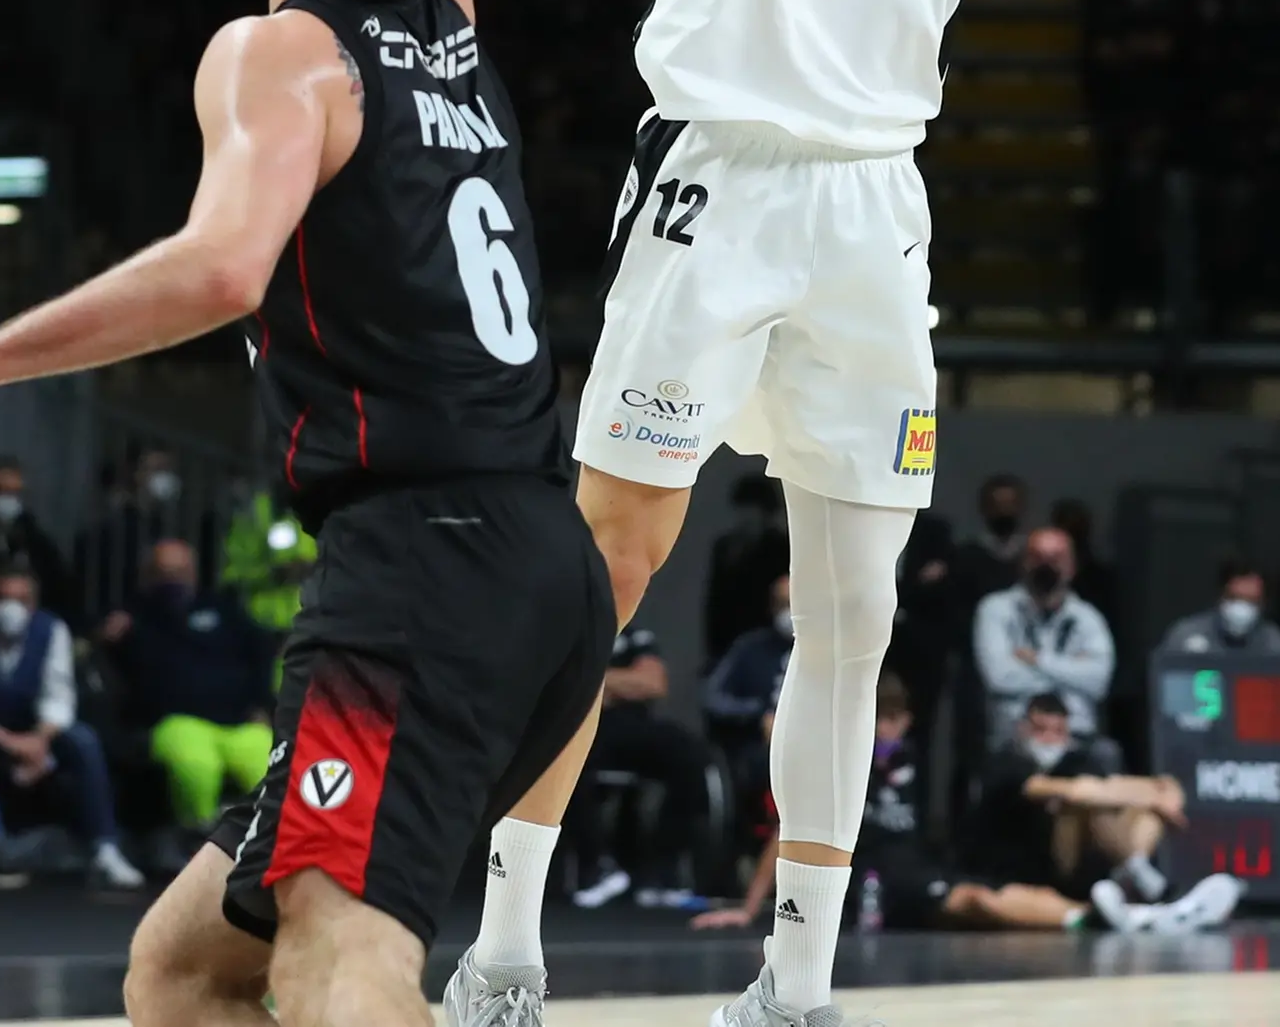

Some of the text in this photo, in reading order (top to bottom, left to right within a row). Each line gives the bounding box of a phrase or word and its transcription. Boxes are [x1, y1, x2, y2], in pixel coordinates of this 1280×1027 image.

[652, 178, 709, 246] 12
[447, 176, 538, 365] 6
[621, 388, 705, 417] CAVIT
[643, 410, 688, 423] TRENTO
[635, 425, 700, 449] Dolomiti
[658, 449, 698, 462] energia
